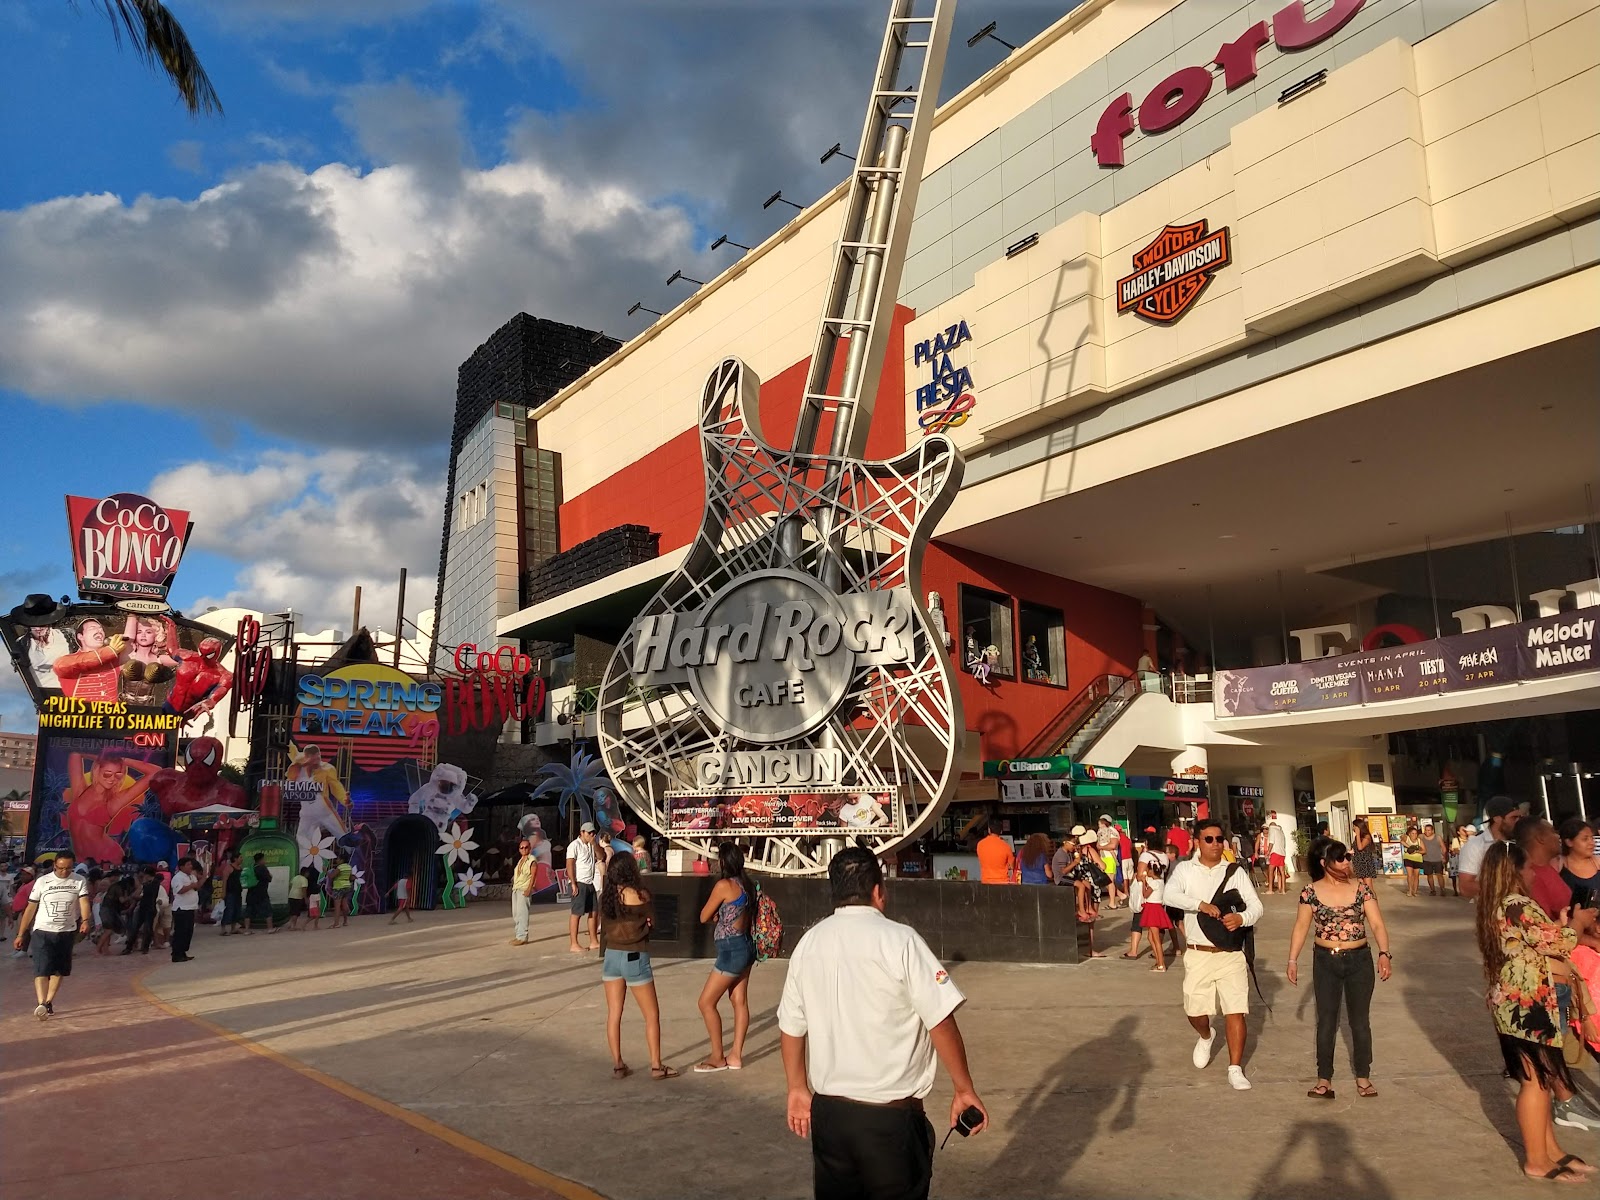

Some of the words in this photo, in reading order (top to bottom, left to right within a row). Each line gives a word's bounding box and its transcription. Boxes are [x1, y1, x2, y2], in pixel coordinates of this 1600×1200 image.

[1143, 230, 1194, 268] MOTOR
[1122, 238, 1221, 303] HARLEY-DAVIDSON
[1145, 275, 1198, 314] CYCLES
[914, 320, 972, 367] PLAZA
[932, 353, 955, 381] LA
[916, 366, 974, 413] FIESTA
[96, 498, 170, 532] CoCo
[82, 525, 181, 578] BONGO
[90, 580, 118, 591] Show
[120, 583, 130, 591] &
[132, 584, 160, 594] Disco
[126, 602, 160, 610] cancun
[632, 603, 769, 674] Hard
[771, 590, 909, 671] Rock
[1527, 618, 1596, 648] Melody
[454, 643, 531, 676] CoCo
[1337, 657, 1376, 668] EVENTS
[1395, 649, 1426, 659] APRIL
[1458, 652, 1479, 670] STEVE
[1536, 644, 1592, 669] Maker
[1272, 680, 1297, 689] DAVID
[1310, 674, 1334, 685] DIMITRI
[1334, 671, 1357, 680] VEGAS
[1419, 680, 1429, 688] 20
[1433, 677, 1448, 685] APR
[1478, 671, 1494, 679] APR
[297, 674, 441, 712] SPRING
[443, 672, 546, 737] BONGO
[734, 679, 805, 708] CAFE
[1270, 686, 1300, 696] GUETTA
[40, 714, 103, 729] NIGHTLIFE
[109, 716, 125, 729] TO
[91, 701, 127, 714] VEGAS
[299, 708, 407, 737] BREAK
[700, 752, 839, 787] CANCUN
[261, 779, 324, 792] BHEMIAN
[1175, 783, 1199, 794] express
[787, 815, 813, 823] COVER
